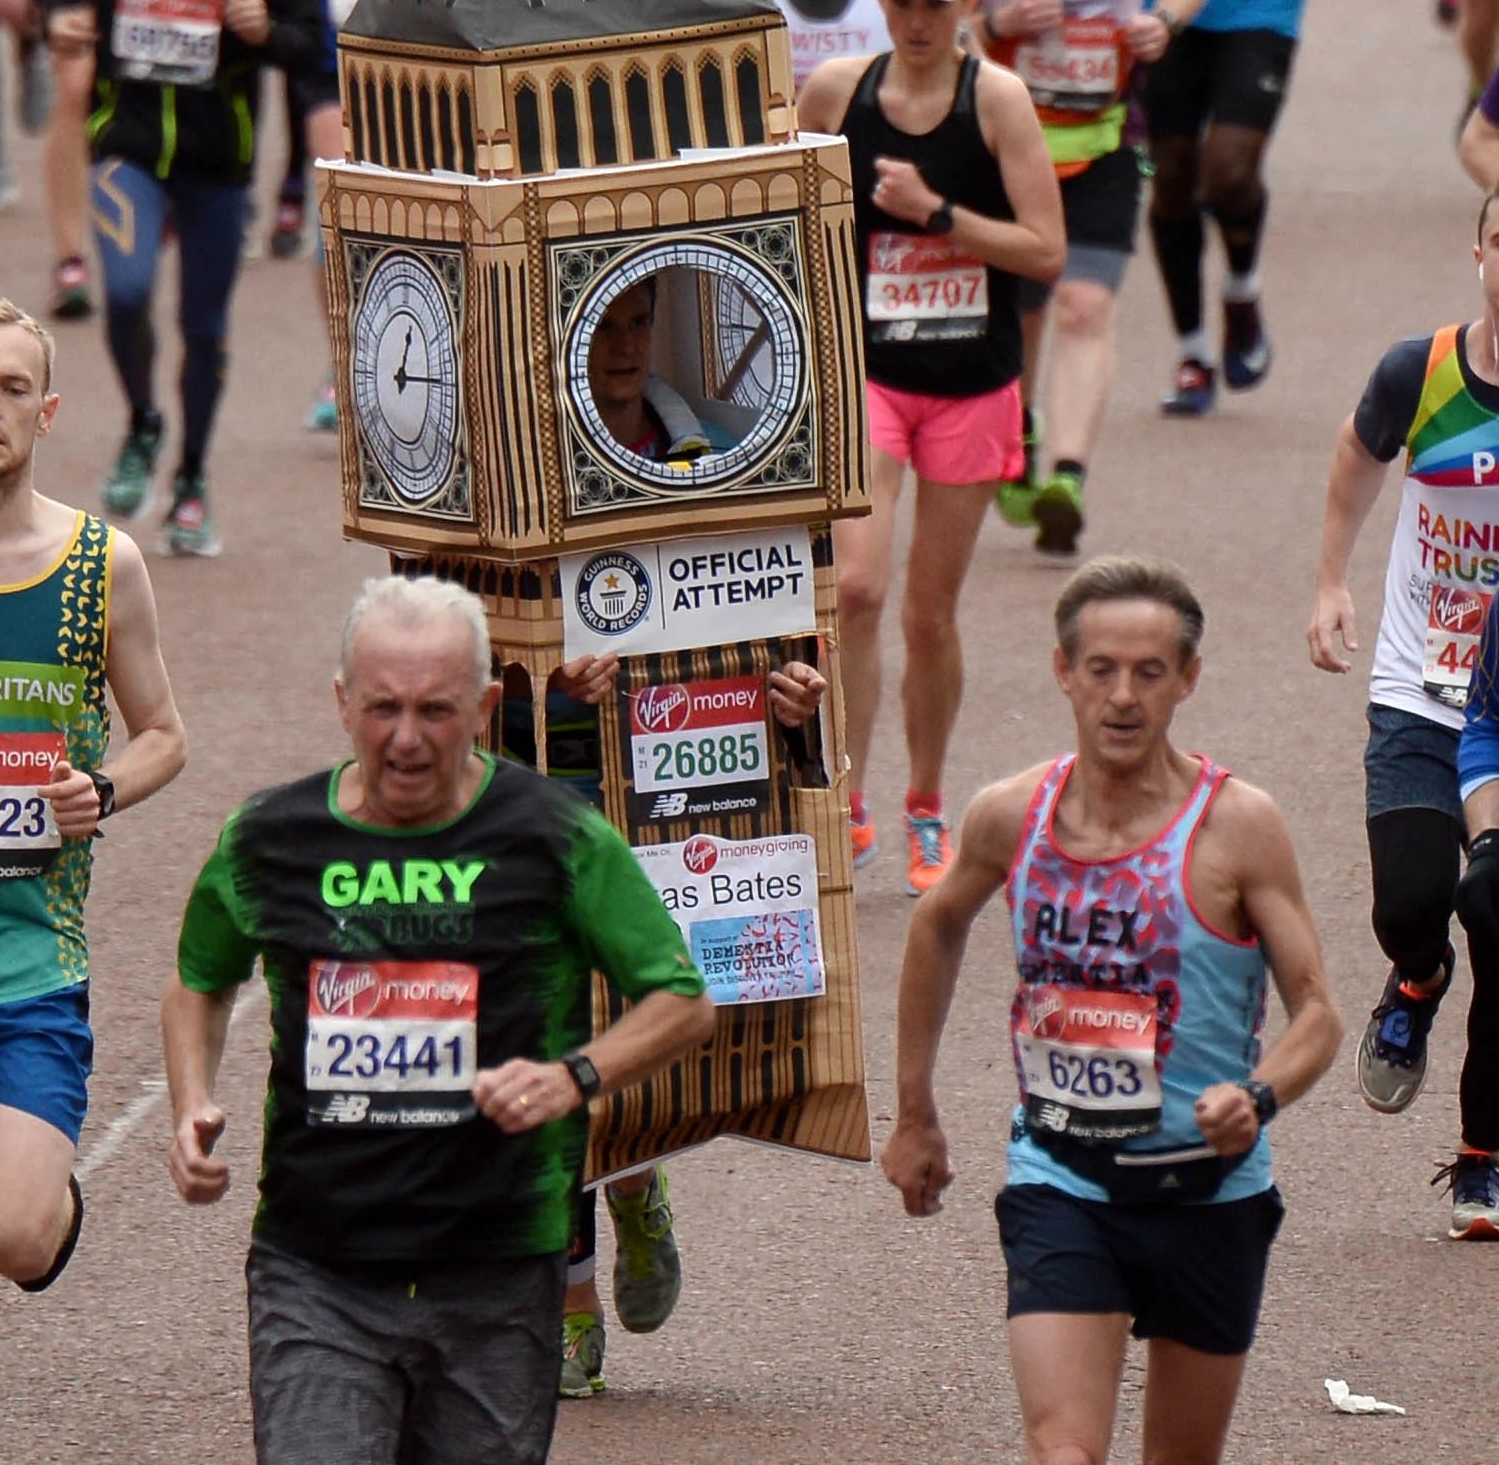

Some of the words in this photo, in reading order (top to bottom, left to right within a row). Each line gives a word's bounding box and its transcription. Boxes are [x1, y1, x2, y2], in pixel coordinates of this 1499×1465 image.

[883, 277, 982, 311] 34707
[583, 555, 639, 582] GUINNESS
[669, 544, 801, 581] OFFICIAL
[578, 591, 606, 630] WORLD
[610, 584, 648, 630] RECORDS
[673, 573, 803, 611] ATTEMPT
[1436, 592, 1481, 630] Virgin
[640, 686, 685, 728] Virgin
[693, 689, 758, 711] money
[653, 733, 759, 781] 26885
[689, 802, 711, 814] new
[713, 797, 756, 811] balance
[685, 842, 716, 870] Virgin
[322, 860, 485, 907] GARY
[711, 872, 802, 905] Bates
[1034, 904, 1139, 950] ALEX
[702, 940, 783, 960] DEMENTIA
[317, 962, 375, 1015] Virgin
[384, 981, 470, 1005] money
[1068, 1007, 1152, 1034] money
[327, 1034, 463, 1079] 23441
[1049, 1051, 1143, 1098] 6263
[371, 1112, 398, 1124] new
[401, 1111, 461, 1123] balance
